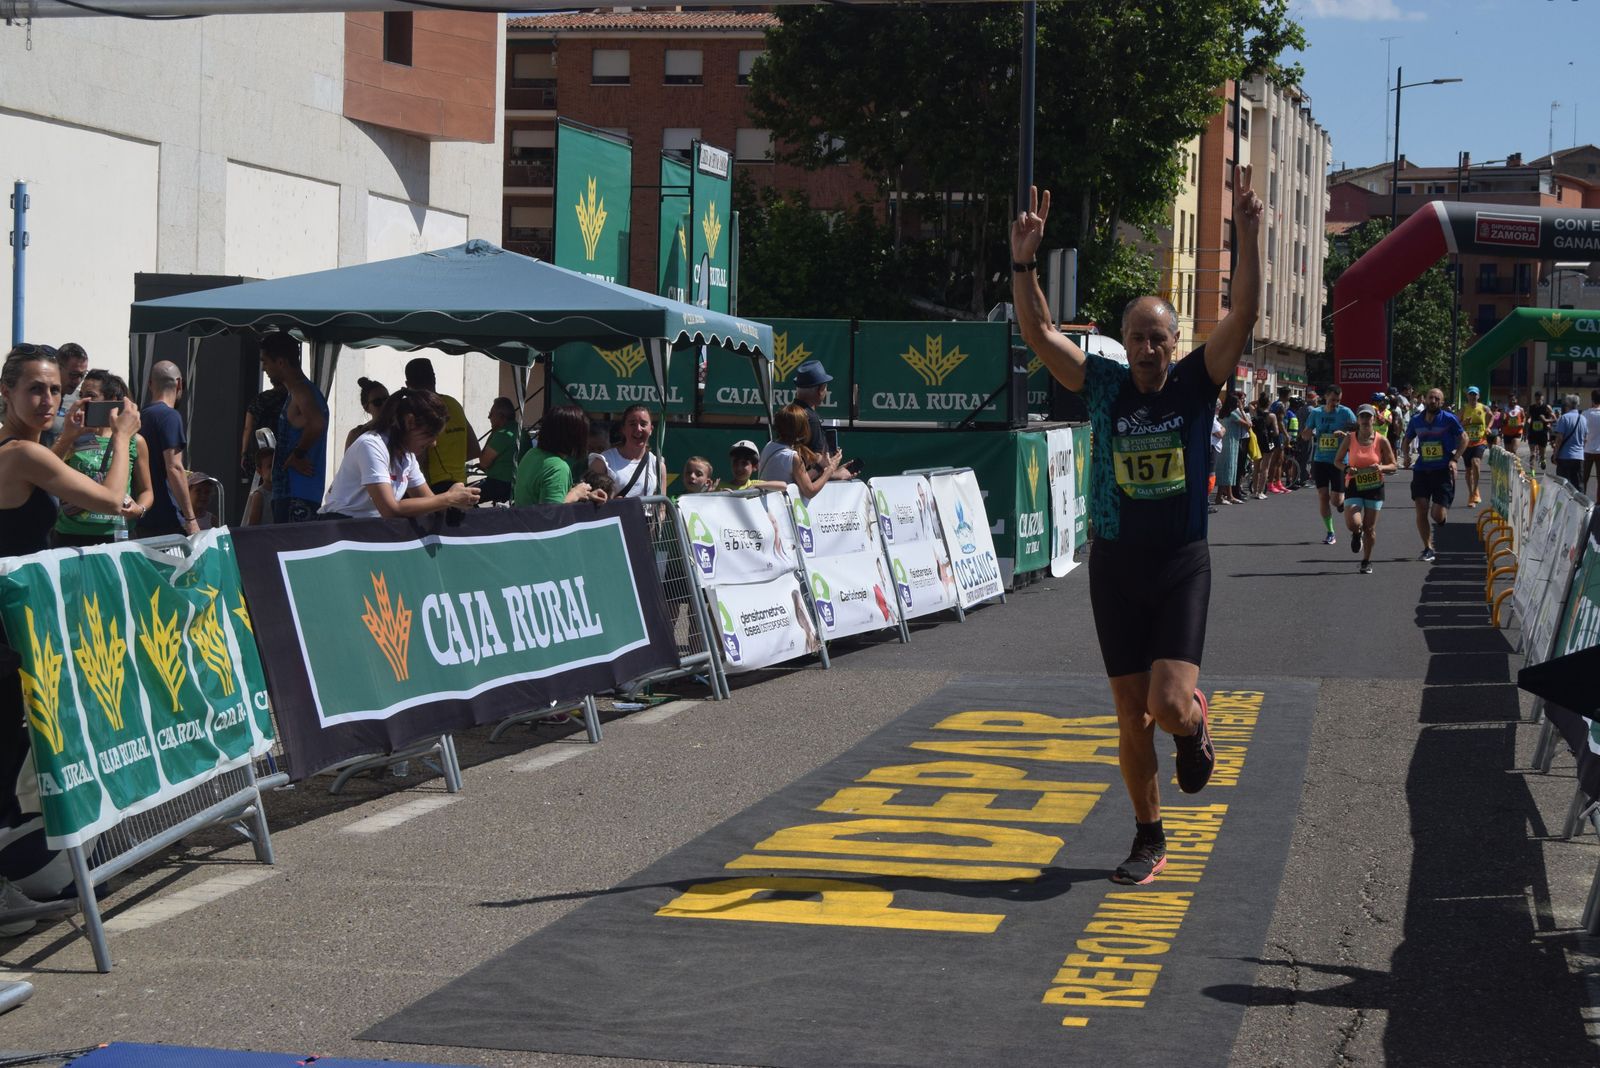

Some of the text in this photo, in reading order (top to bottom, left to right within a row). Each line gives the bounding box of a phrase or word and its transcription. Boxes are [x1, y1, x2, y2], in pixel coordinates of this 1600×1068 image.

[1554, 218, 1587, 231] CON
[1490, 230, 1536, 242] ZAMORA
[564, 383, 611, 401] CAJA
[716, 387, 838, 408] CAJA RUL
[872, 392, 997, 411] CAJA RURAL
[1321, 438, 1336, 447] 142
[1426, 446, 1438, 456] 62
[1123, 453, 1173, 481] 157
[1357, 472, 1378, 484] 0968
[954, 550, 998, 590] OCEANIC
[422, 576, 603, 666] CAJA RURAL
[97, 735, 152, 775] CAJA RURAL
[1041, 802, 1229, 1009] REFORMA INTEGRAL
